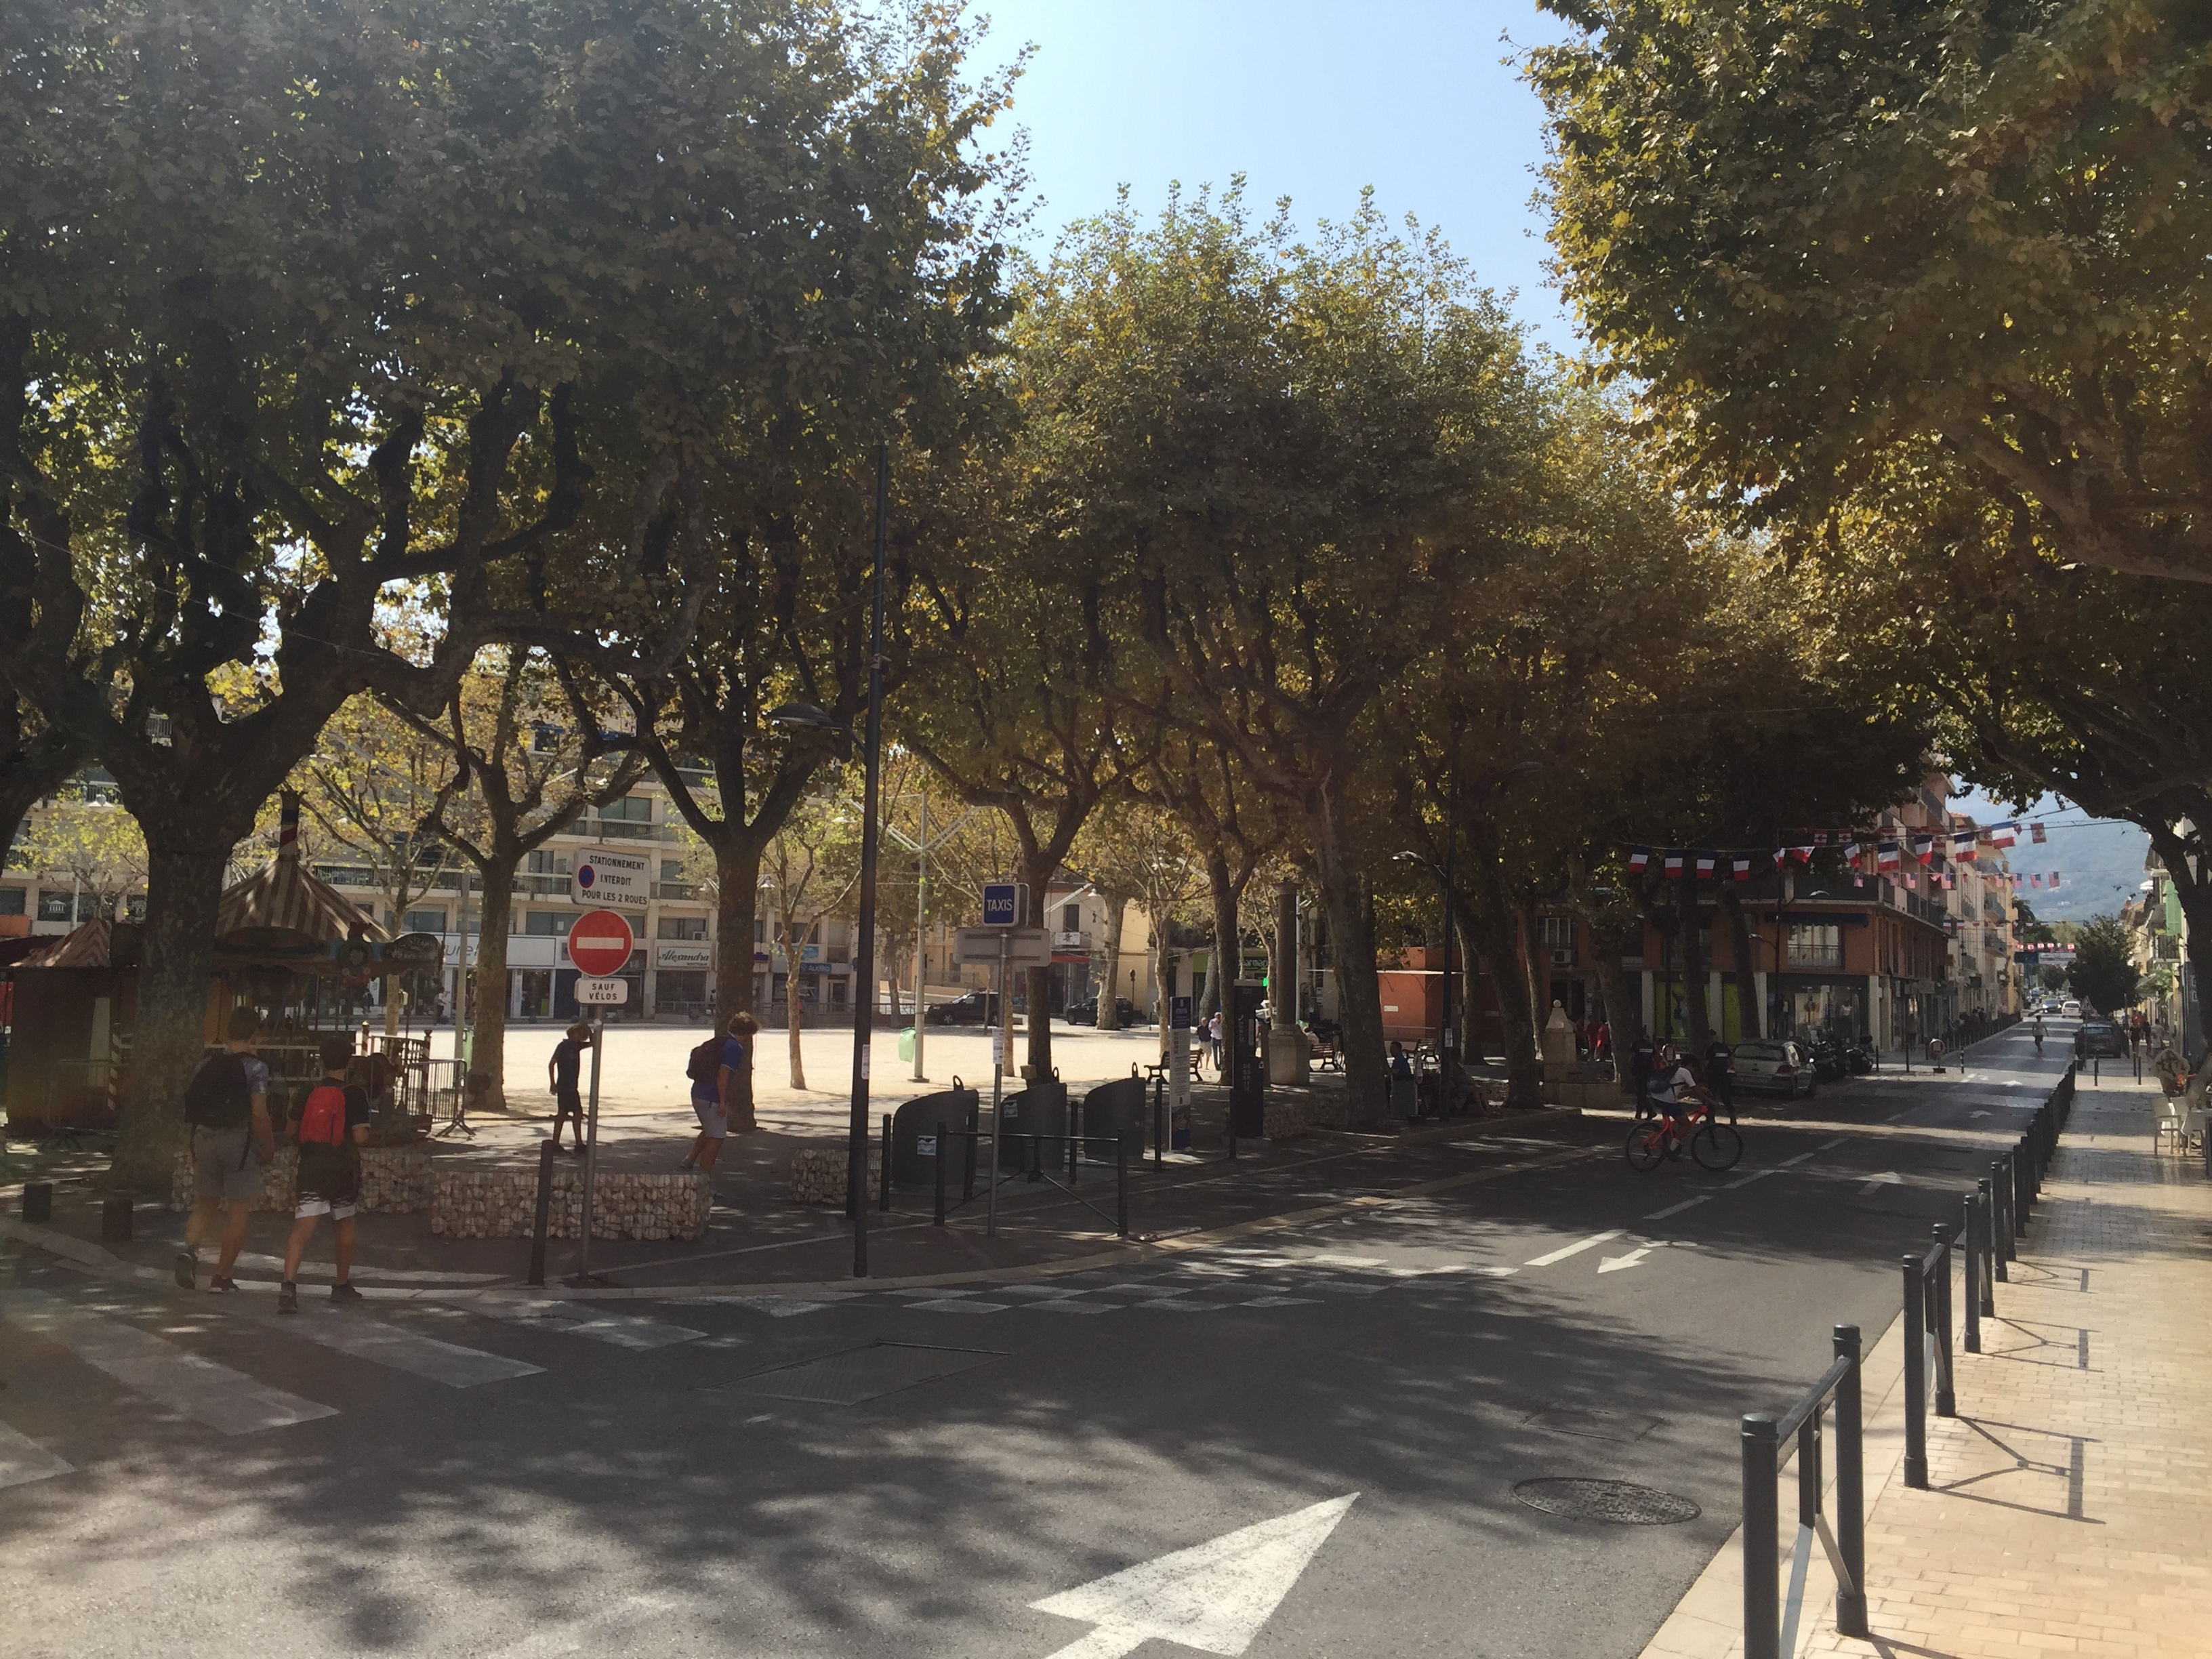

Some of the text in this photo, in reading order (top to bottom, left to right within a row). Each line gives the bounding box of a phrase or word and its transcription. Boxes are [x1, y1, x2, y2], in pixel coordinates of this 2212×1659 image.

[589, 855, 645, 871] STATIONNEMENT
[600, 874, 632, 886] INTERDIT
[582, 889, 648, 905] POUR LES 2 ROUES
[987, 898, 1013, 912] TAXIS
[659, 949, 710, 962] Alexandra
[592, 983, 615, 991] SAUF
[589, 991, 617, 1001] VÉLOS
